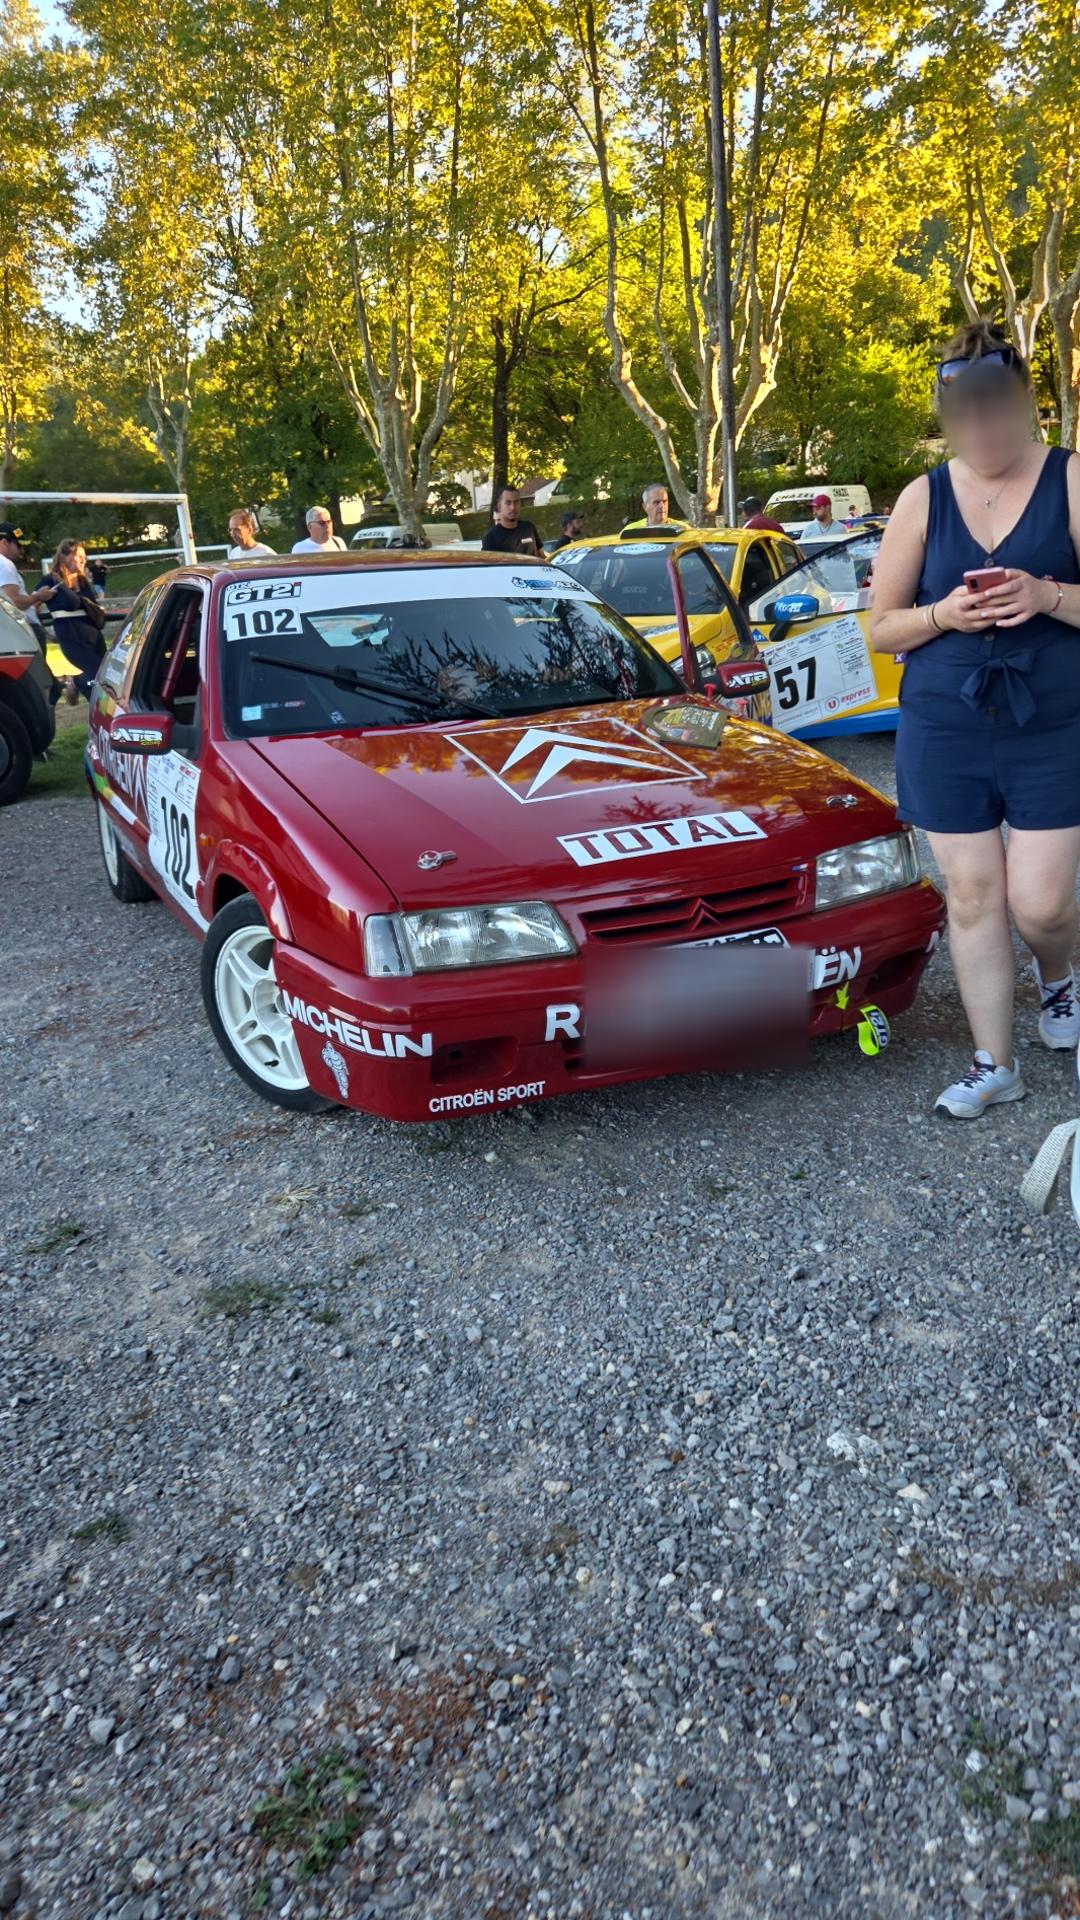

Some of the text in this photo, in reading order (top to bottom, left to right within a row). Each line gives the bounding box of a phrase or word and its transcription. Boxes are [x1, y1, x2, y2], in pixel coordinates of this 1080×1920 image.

[232, 608, 297, 637] 102
[774, 656, 817, 710] 57
[841, 686, 871, 702] express
[161, 796, 195, 900] 102
[564, 814, 758, 860] TOTAL
[544, 945, 862, 1042] R ËN
[282, 989, 433, 1058] MICHELIN
[429, 1081, 546, 1113] CITROËN SPORT
